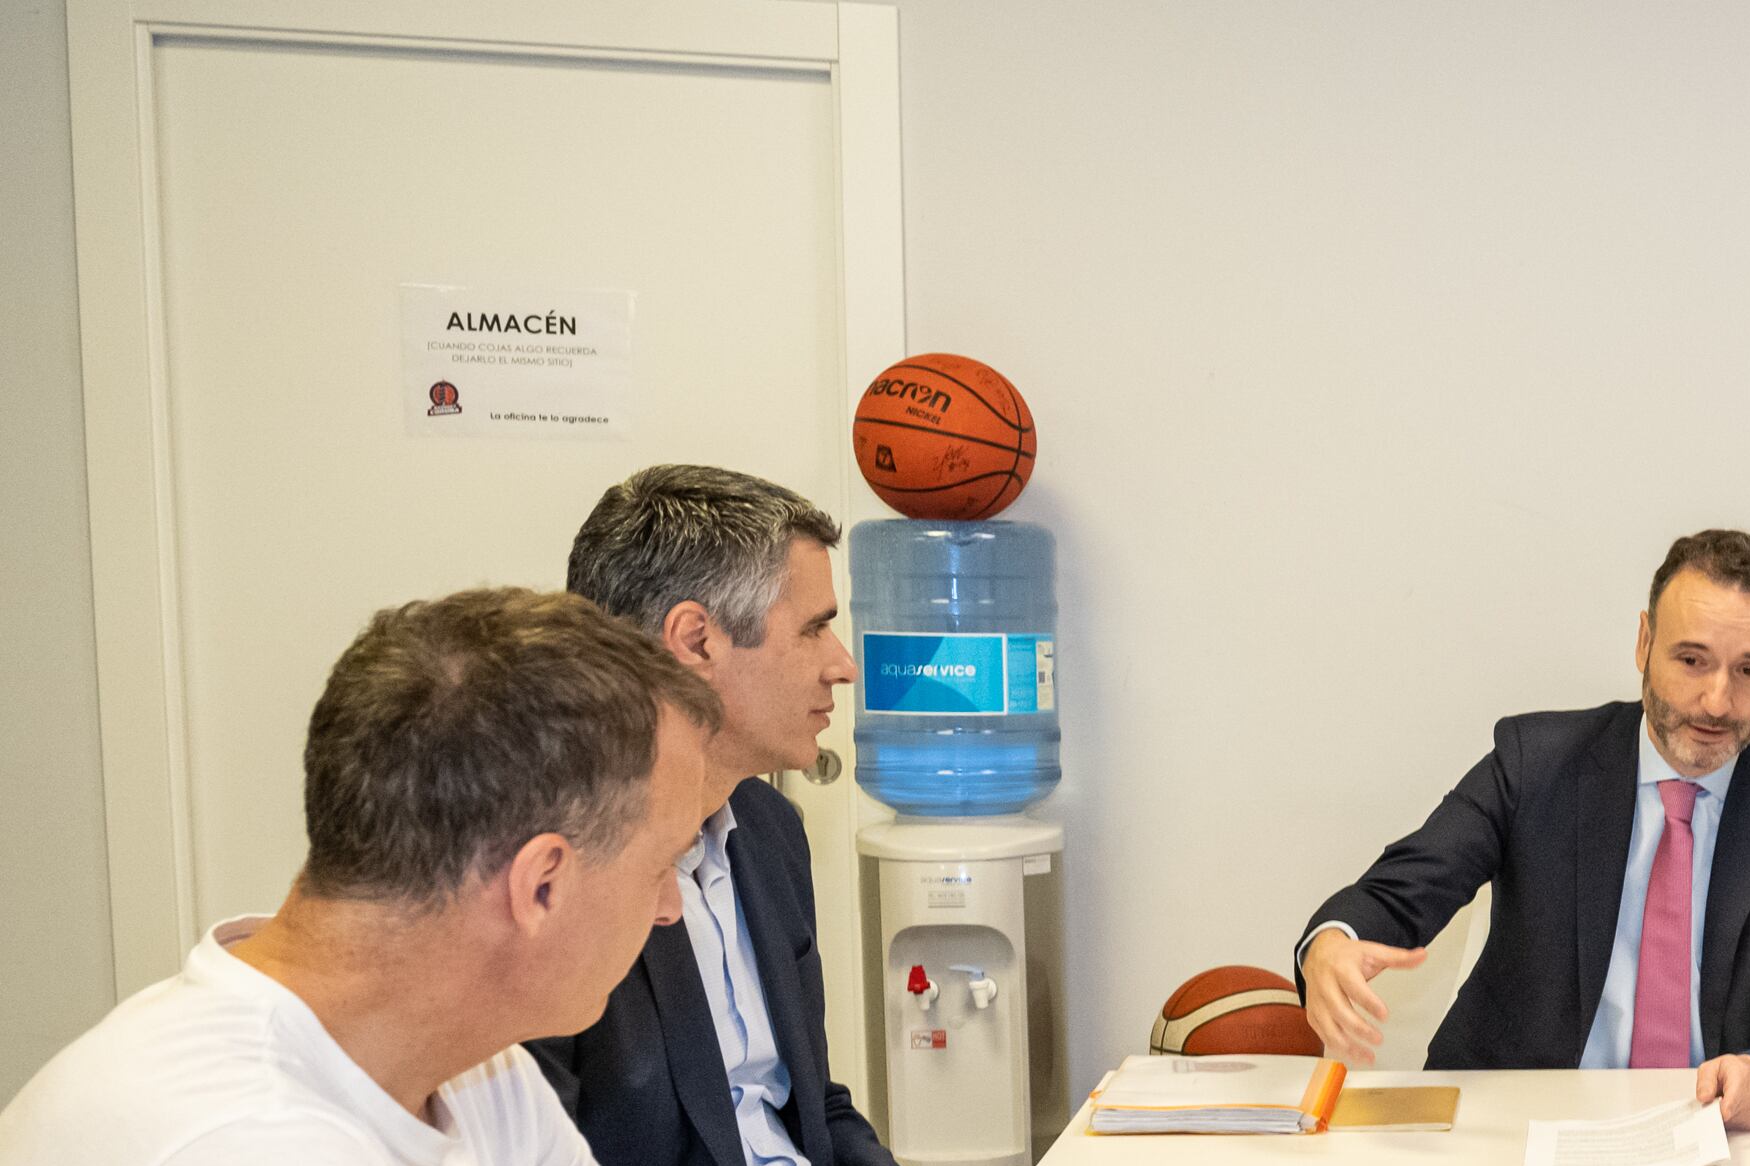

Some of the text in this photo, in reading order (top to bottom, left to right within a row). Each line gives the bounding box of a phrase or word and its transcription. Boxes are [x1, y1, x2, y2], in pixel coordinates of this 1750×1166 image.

[446, 310, 577, 336] ALMACÉN
[478, 343, 513, 353] COJAS
[514, 345, 544, 354] ALGO
[545, 345, 598, 356] RECUERDA
[451, 354, 497, 364] DEJARLO
[498, 356, 508, 365] EL
[510, 357, 545, 367] MISMO
[490, 412, 610, 425] La oficina te lo agradece
[880, 662, 977, 680] aquaservice
